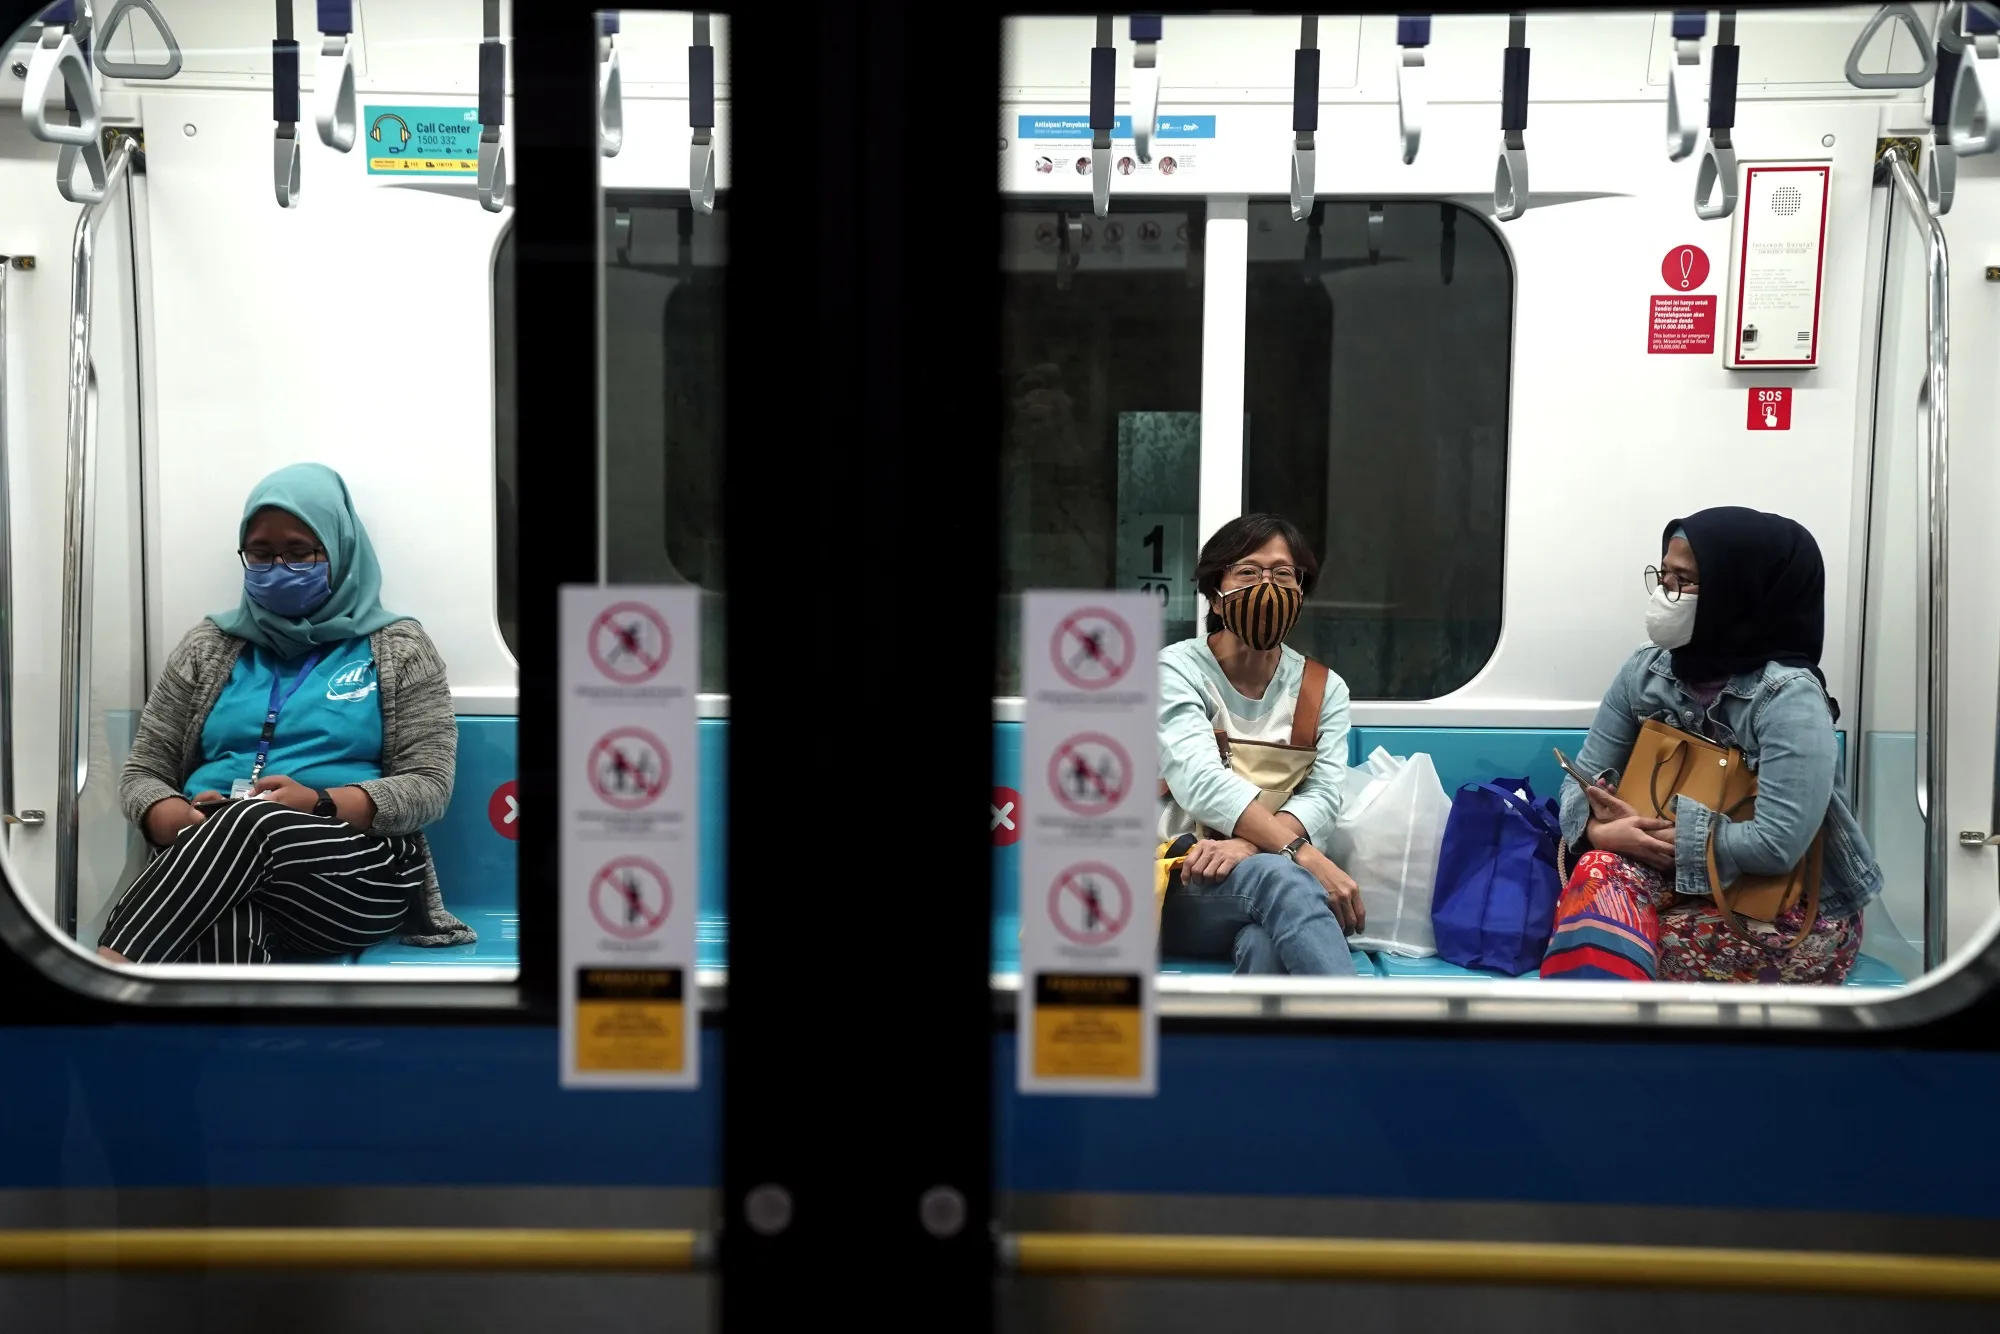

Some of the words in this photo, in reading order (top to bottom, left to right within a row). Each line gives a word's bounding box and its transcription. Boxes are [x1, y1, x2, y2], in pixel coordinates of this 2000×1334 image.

[416, 123, 436, 133] Call
[438, 123, 471, 134] Center
[1034, 121, 1061, 129] Antisipasi
[1062, 121, 1090, 129] Penyebara
[417, 135, 438, 145] 1500
[440, 136, 456, 145] 332
[1758, 390, 1782, 401] SOS
[1143, 525, 1163, 573] 1
